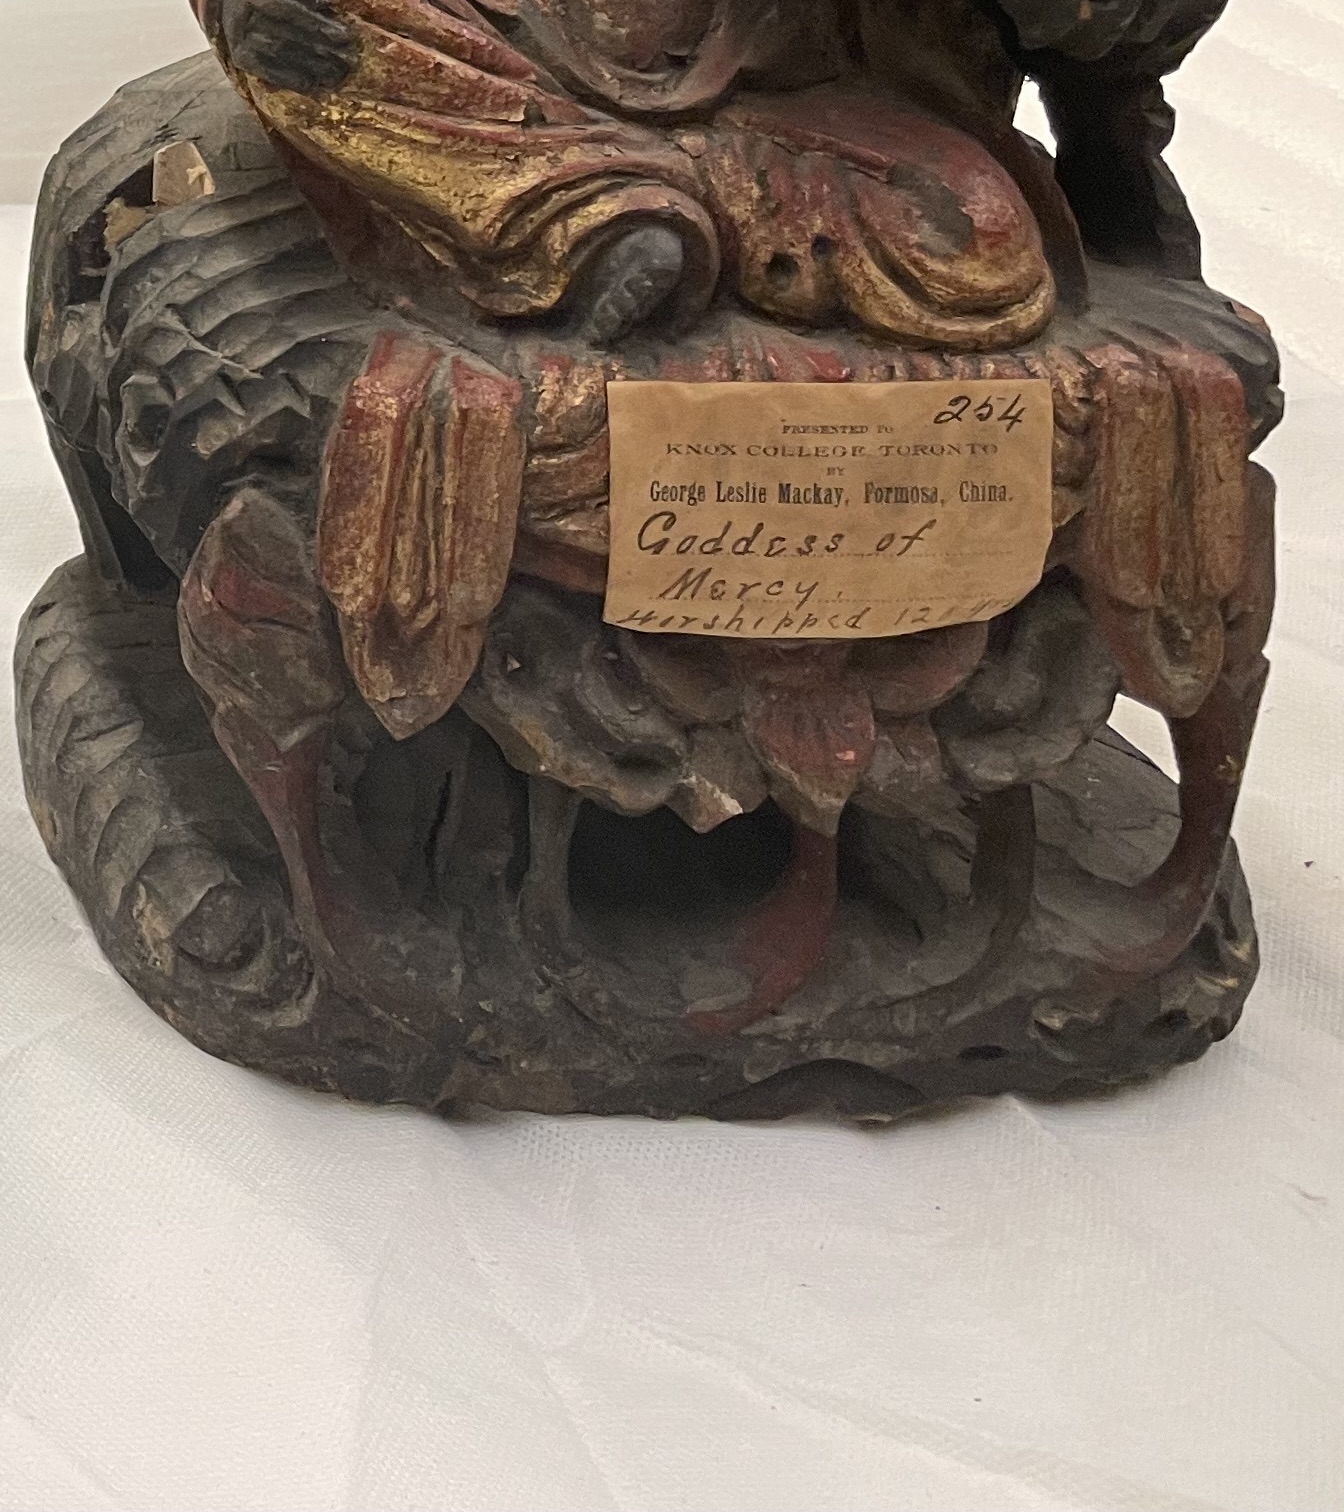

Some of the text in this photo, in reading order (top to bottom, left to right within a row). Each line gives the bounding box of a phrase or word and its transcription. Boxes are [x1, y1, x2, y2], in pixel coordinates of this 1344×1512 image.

[933, 394, 1026, 433] 254
[781, 424, 869, 435] PRESENTED
[666, 443, 738, 456] KNOX
[827, 467, 845, 476] BY
[650, 480, 1014, 508] George Leslie Mackay, Formosa, China.
[638, 511, 936, 557] Goddess of
